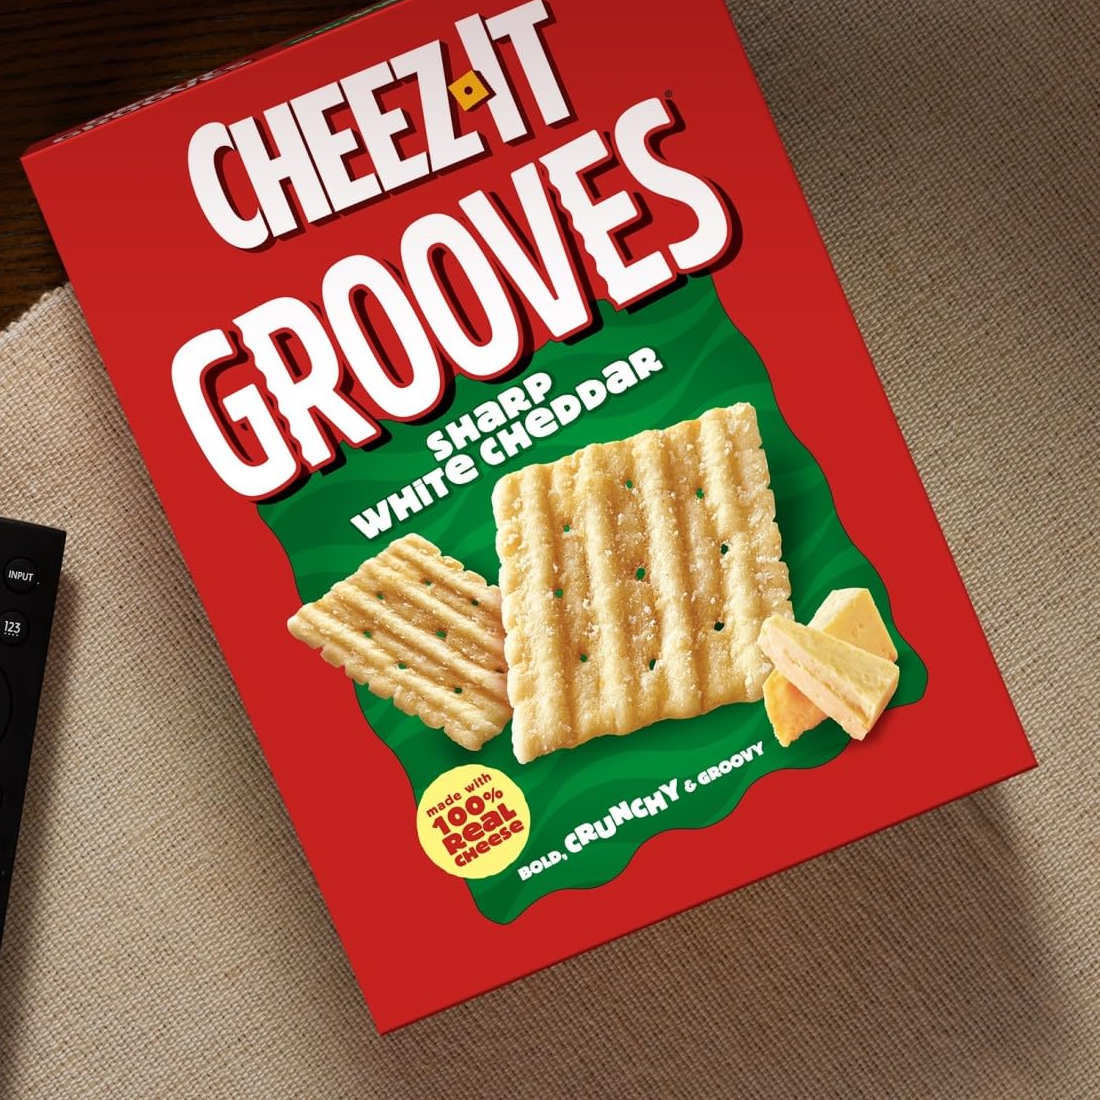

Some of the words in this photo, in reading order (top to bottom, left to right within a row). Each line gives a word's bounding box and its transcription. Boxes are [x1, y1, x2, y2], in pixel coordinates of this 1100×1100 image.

[171, 97, 729, 498] GROOVES
[8, 569, 35, 582] INPUT
[4, 620, 21, 634] 123
[426, 792, 462, 818] made
[464, 773, 492, 793] with
[432, 787, 504, 836] 100%
[517, 849, 568, 881] BOLD,
[564, 778, 680, 853] CRUNCHY
[684, 780, 697, 793] &
[697, 741, 765, 785] GROOVY
